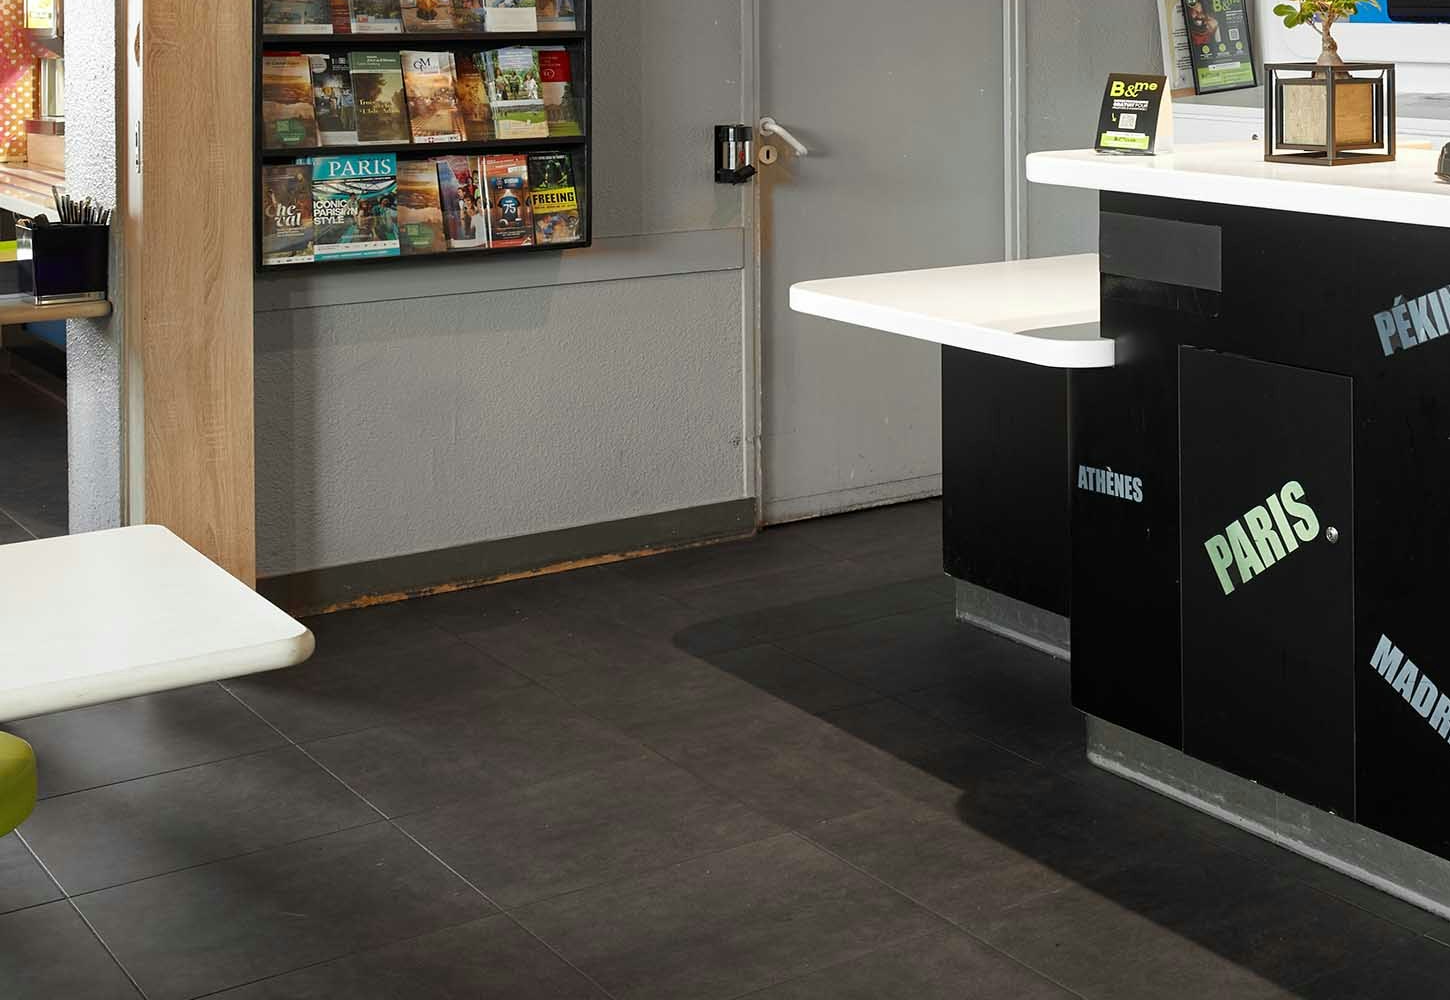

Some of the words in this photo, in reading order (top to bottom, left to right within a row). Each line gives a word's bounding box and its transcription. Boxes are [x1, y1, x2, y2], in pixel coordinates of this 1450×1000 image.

[1110, 80, 1159, 97] B&me
[328, 158, 392, 177] PARIS
[313, 199, 348, 209] ICONIC
[532, 191, 575, 206] FREEING
[503, 203, 516, 214] 75
[313, 216, 345, 225] STYLE
[1077, 464, 1144, 503] ATHÈNES
[1204, 480, 1320, 595] PARIS
